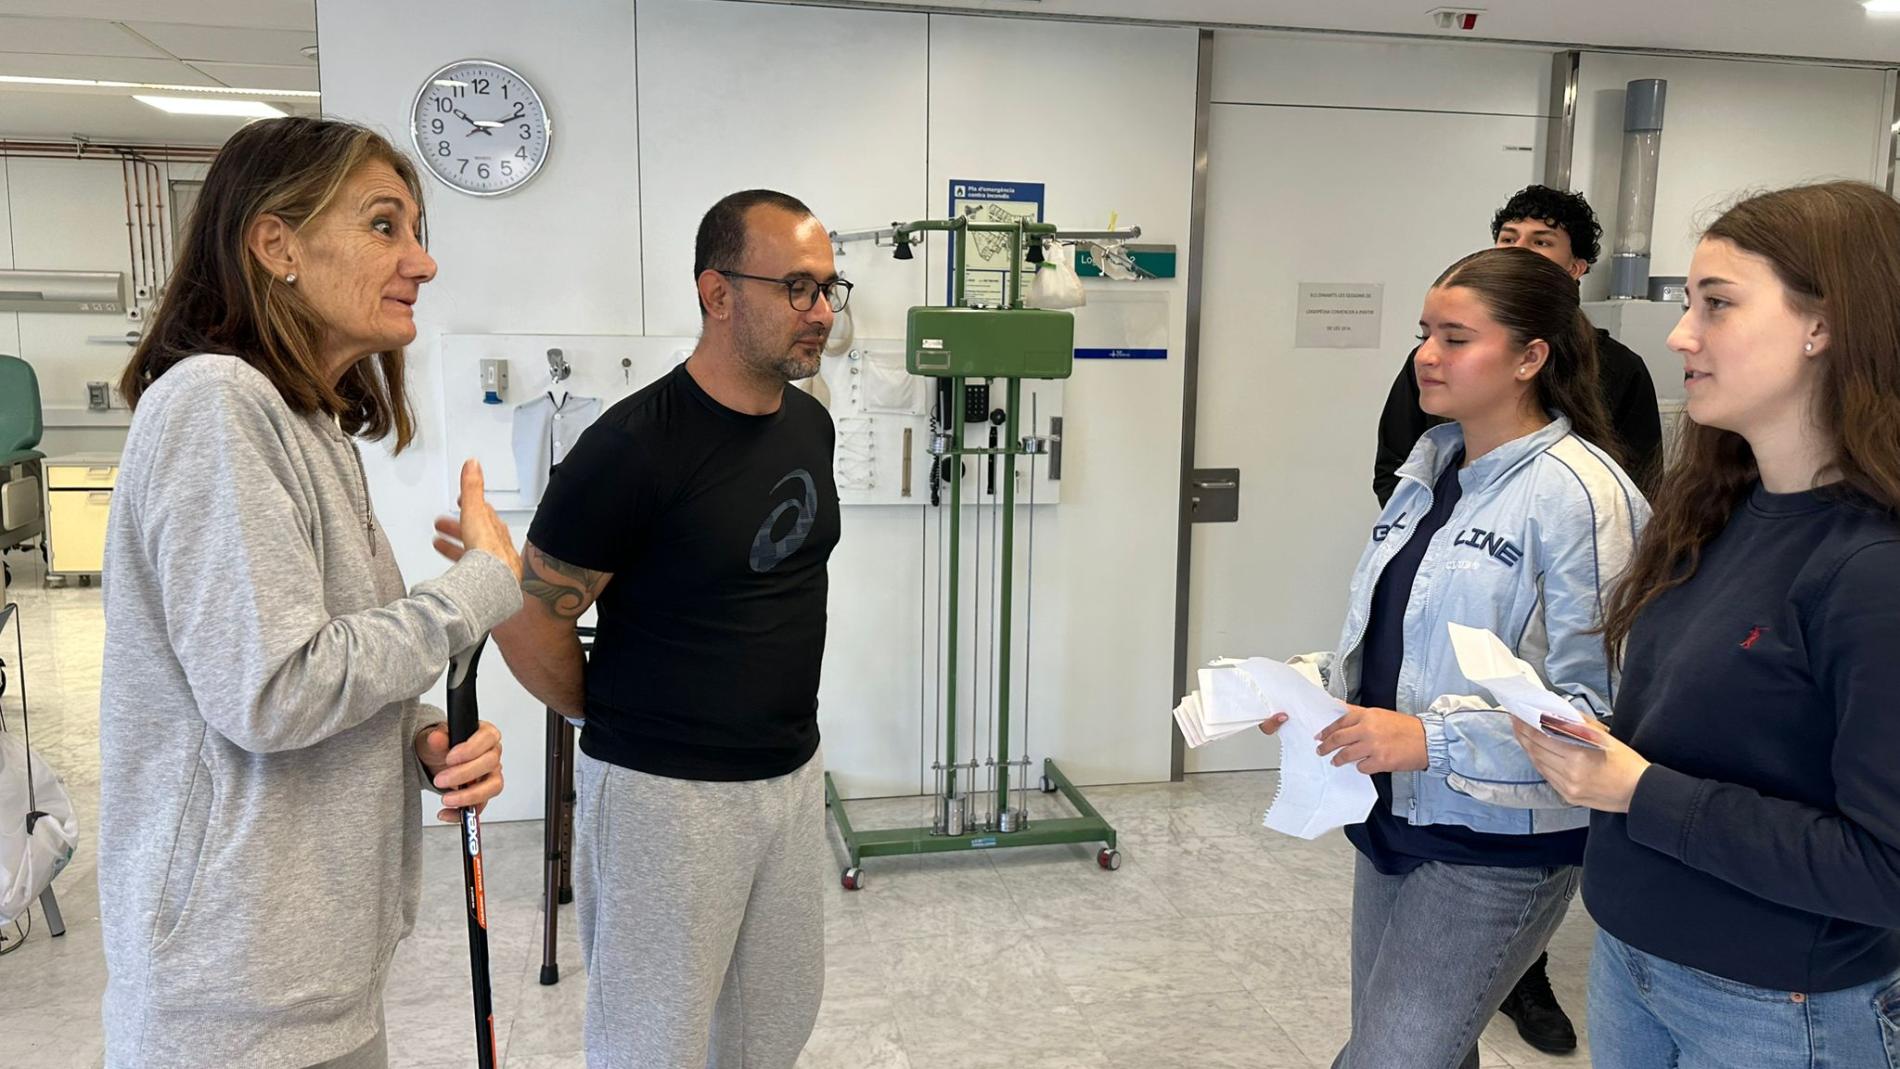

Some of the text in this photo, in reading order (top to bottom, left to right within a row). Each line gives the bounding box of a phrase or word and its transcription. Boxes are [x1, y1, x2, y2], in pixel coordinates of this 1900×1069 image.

[452, 83, 465, 98] 11
[471, 78, 490, 95] 12
[501, 84, 508, 99] 1
[434, 97, 453, 113] 10
[513, 101, 526, 118] 2
[431, 118, 444, 134] 9
[519, 123, 532, 140] 3
[438, 140, 451, 157] 8
[514, 145, 528, 160] 4
[457, 158, 469, 174] 7
[477, 163, 490, 179] 6
[500, 160, 513, 176] 5
[1454, 527, 1524, 568] LINE
